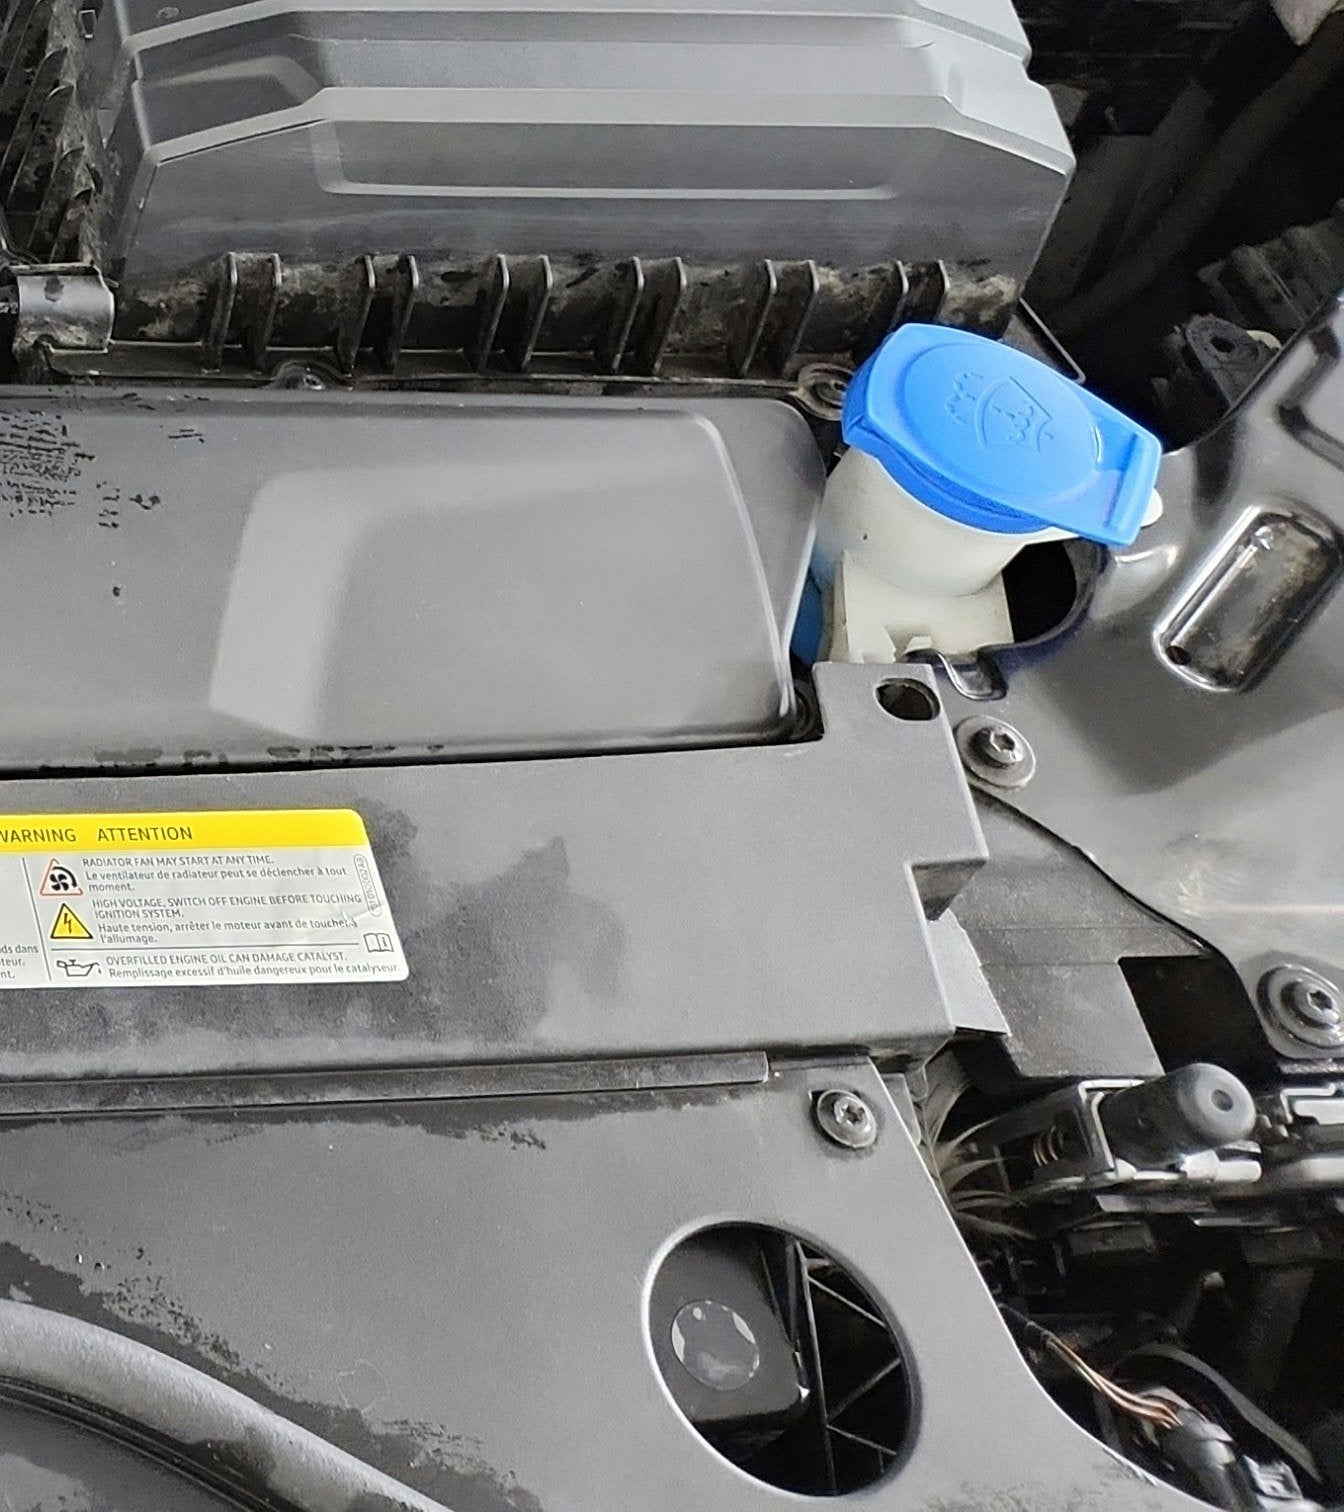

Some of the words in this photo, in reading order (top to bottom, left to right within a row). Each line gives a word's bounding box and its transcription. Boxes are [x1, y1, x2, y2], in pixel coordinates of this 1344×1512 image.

[98, 827, 192, 841] ATTENTION
[83, 858, 132, 867] RADIATOR
[135, 857, 153, 866] FAN
[156, 857, 176, 866] MAY
[179, 857, 209, 865] START
[212, 856, 223, 864] AT
[225, 856, 245, 864] ANY
[247, 855, 274, 864] TIME.
[86, 871, 97, 880] Le
[100, 870, 154, 880] ventilateur
[157, 870, 170, 879] de
[172, 870, 218, 879] radiateur
[221, 869, 244, 879] peut
[246, 870, 257, 878] se
[260, 868, 314, 877] déclencher
[326, 867, 347, 875] tout
[89, 883, 135, 891] moment.
[92, 899, 118, 908] HIGH
[118, 898, 166, 908] VOLTAGE,
[167, 898, 206, 906] SWITCH
[208, 897, 227, 906] OFF
[230, 896, 267, 906] ENGINE
[269, 894, 308, 904] BEFORE
[310, 894, 361, 904] TOUCHING
[95, 910, 140, 919] IGNITION
[142, 909, 184, 918] SYSTEM.
[98, 923, 129, 932] Haute
[132, 923, 173, 933] tension,
[175, 922, 209, 931] arrêter
[212, 921, 221, 930] le
[224, 920, 261, 929] moteur
[264, 920, 292, 929] avant
[295, 919, 307, 928] de
[15, 944, 39, 954] dans
[106, 956, 167, 966] OVERFILLED
[170, 955, 208, 964] ENGINE
[210, 954, 227, 963] OIL
[229, 953, 250, 963] CAN
[252, 952, 295, 962] DAMAGE
[297, 952, 347, 961] CATALYST.
[109, 968, 172, 979] Remplissage
[175, 967, 215, 976] excessif
[217, 965, 251, 976] d'huile
[254, 964, 307, 976] dangereux
[310, 966, 331, 975] pour
[334, 963, 344, 973] le
[346, 963, 400, 973] catalyseur.
